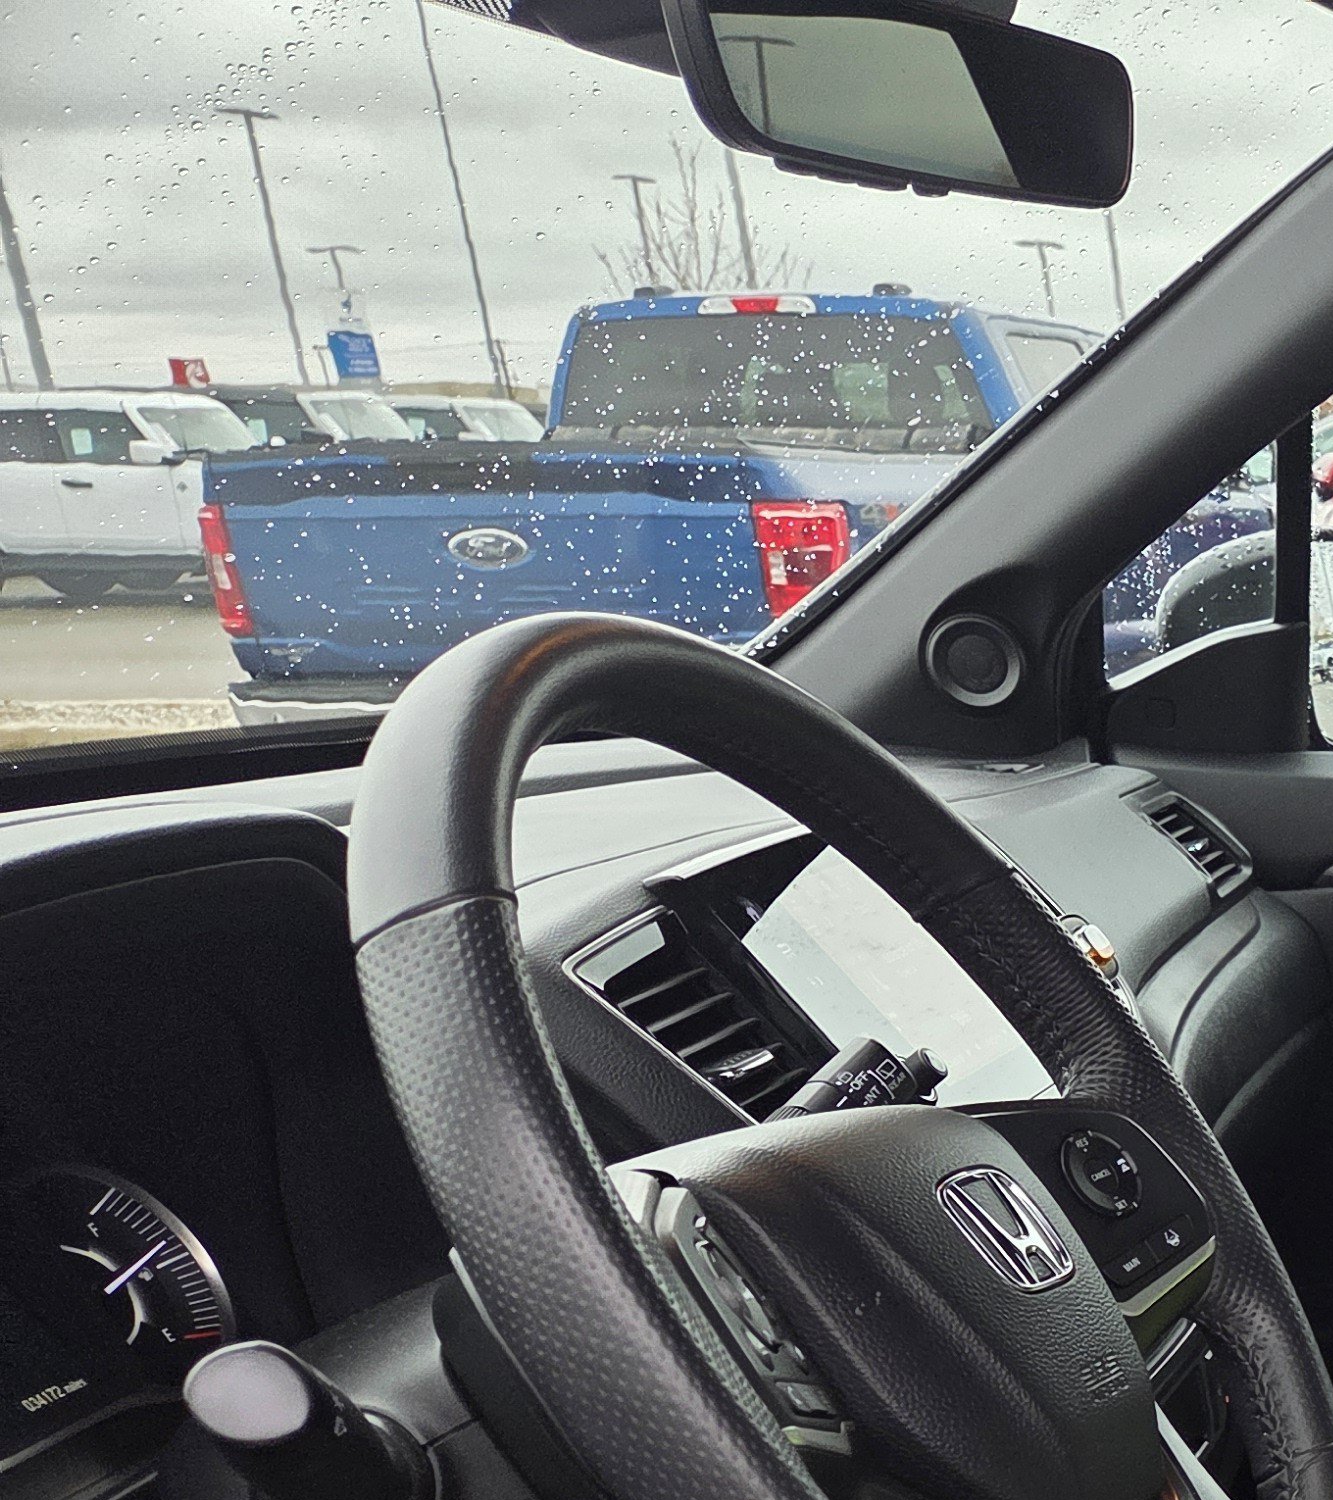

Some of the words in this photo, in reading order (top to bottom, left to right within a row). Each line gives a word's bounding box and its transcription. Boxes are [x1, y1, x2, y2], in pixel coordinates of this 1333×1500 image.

[850, 1070, 869, 1090] OFF
[864, 1085, 882, 1104] INT
[87, 1222, 99, 1238] F
[161, 1327, 176, 1342] E
